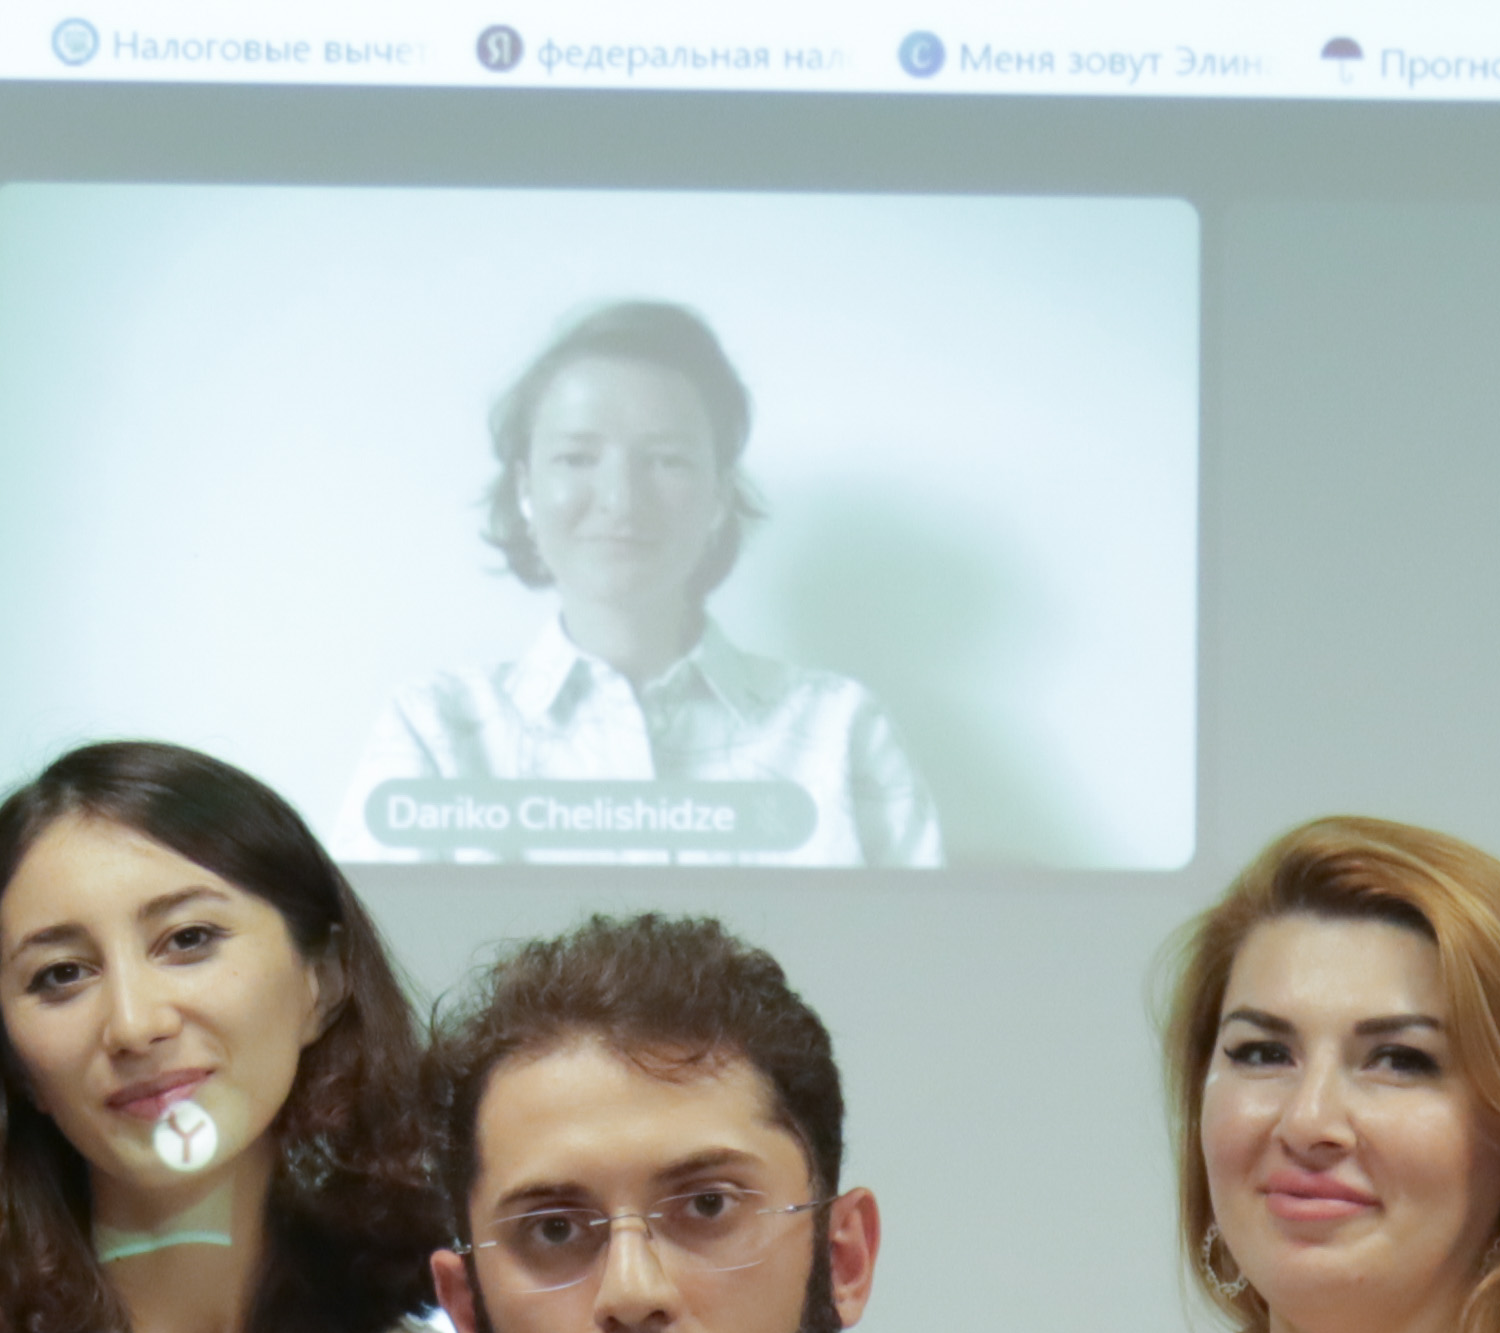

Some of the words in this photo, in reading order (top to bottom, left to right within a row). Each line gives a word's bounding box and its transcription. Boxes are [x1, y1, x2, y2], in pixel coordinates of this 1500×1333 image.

[113, 30, 312, 65] Налоговые
[537, 38, 770, 76] федеральная
[960, 44, 1055, 74] Меня
[1068, 49, 1163, 83] зовут
[387, 794, 510, 831] Dariko
[518, 795, 736, 833] Chelishidze
